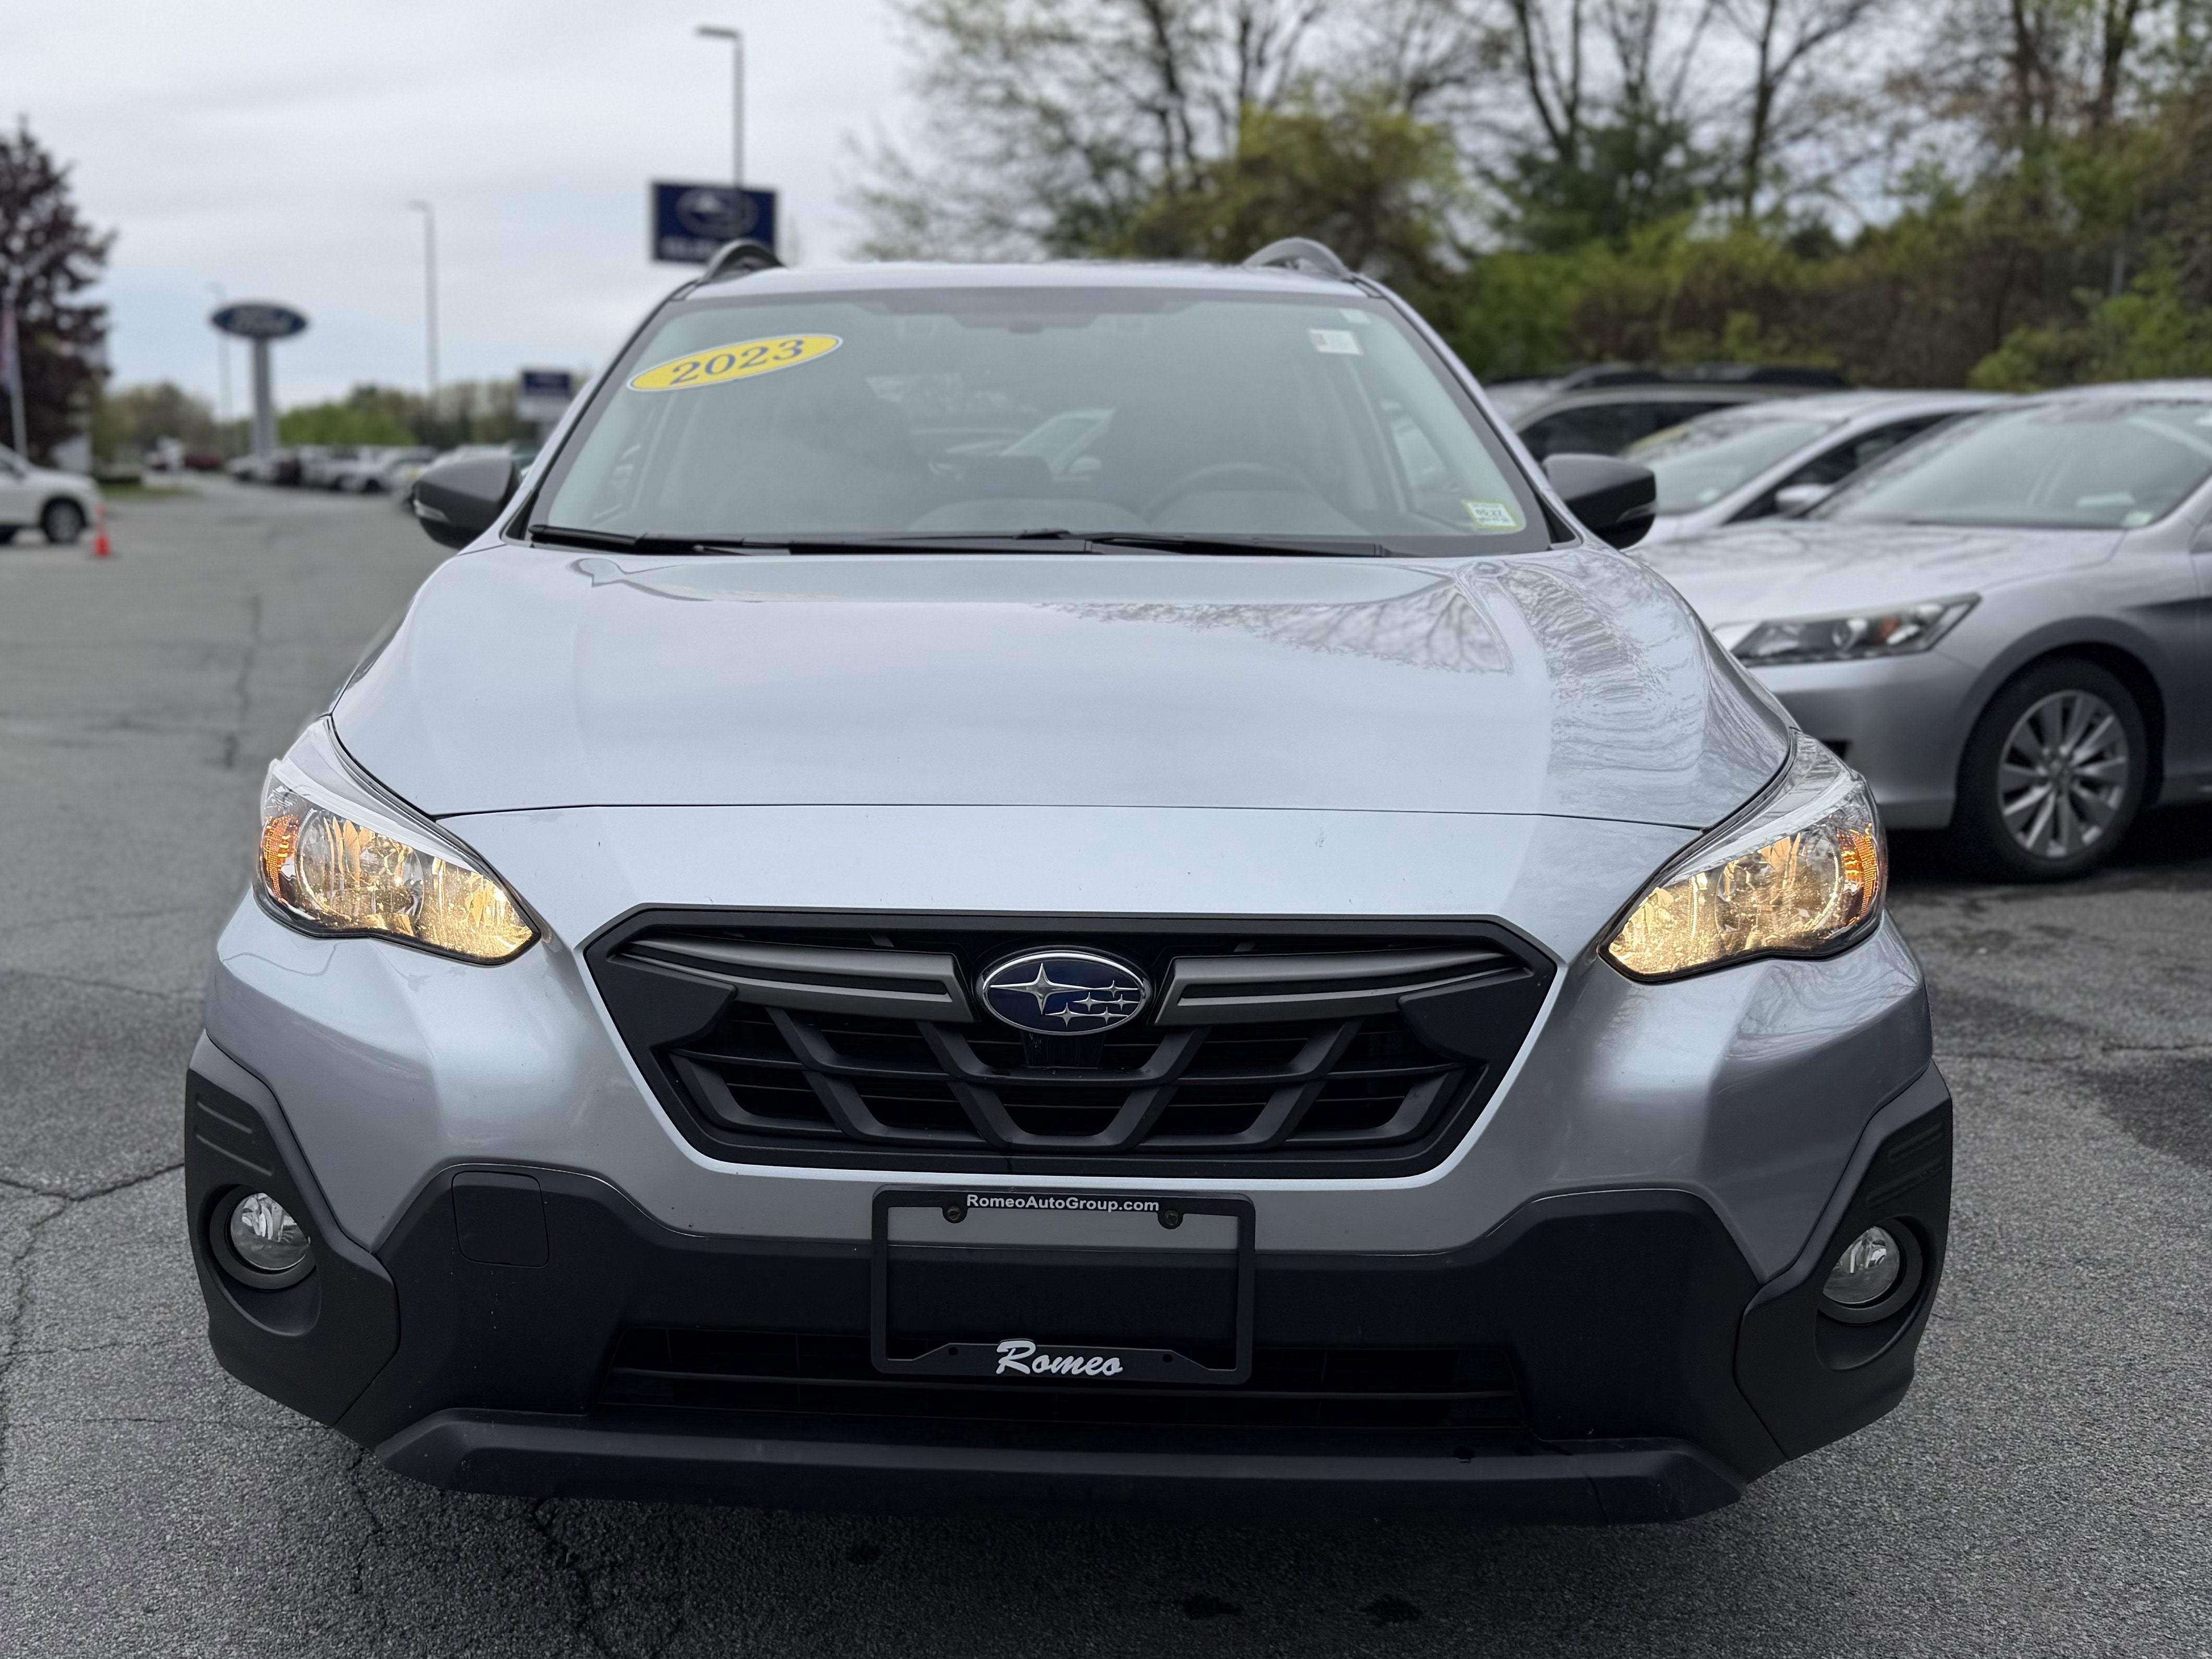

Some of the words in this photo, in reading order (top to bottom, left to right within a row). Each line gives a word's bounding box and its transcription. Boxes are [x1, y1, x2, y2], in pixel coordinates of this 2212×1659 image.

[670, 340, 804, 385] 2023
[967, 1194, 1159, 1213] RomeoAutoGroup.com
[996, 1340, 1123, 1376] Romeo
